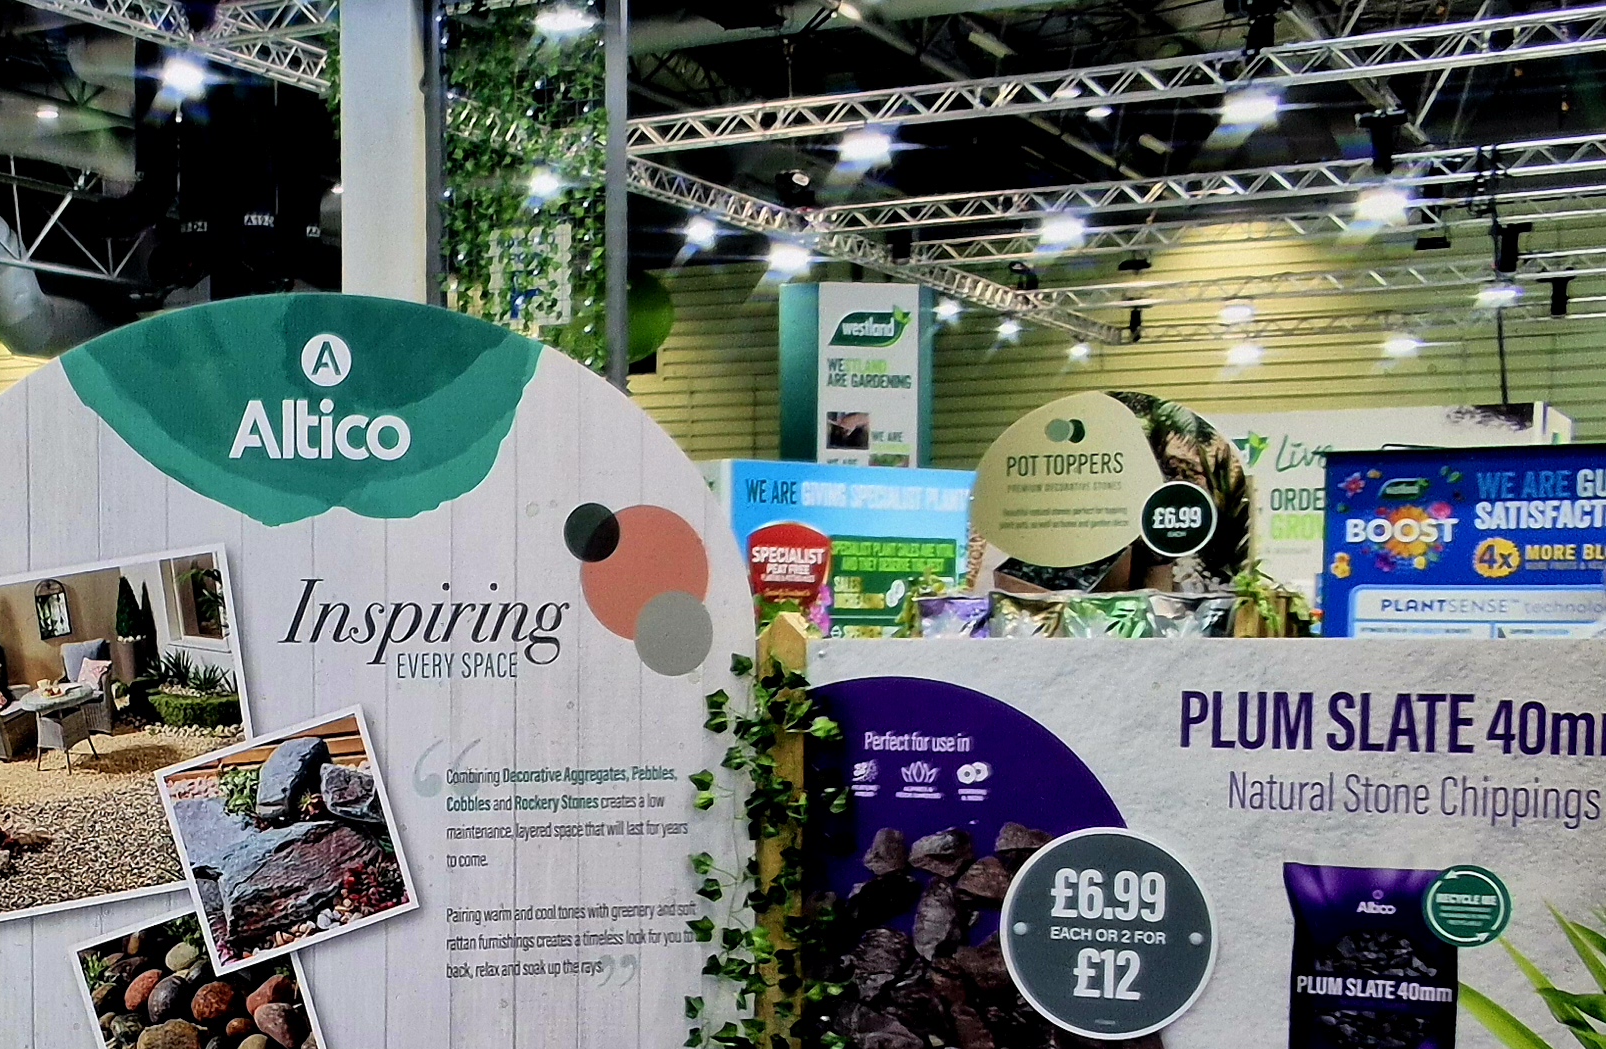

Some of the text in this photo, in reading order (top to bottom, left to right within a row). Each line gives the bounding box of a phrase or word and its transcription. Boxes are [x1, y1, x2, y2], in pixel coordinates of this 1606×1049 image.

[842, 316, 894, 337] westland
[827, 373, 912, 389] ARE GARDENING
[228, 398, 411, 460] Altico
[1006, 452, 1124, 477] POT TOPPERS
[746, 478, 766, 503] WE
[772, 480, 797, 504] ARE
[852, 483, 922, 510] SPECIALIST
[1476, 471, 1515, 499] WE
[1522, 470, 1572, 499] ARE
[1152, 506, 1202, 529] £6.99
[1345, 518, 1459, 543] BOOST
[751, 546, 825, 565] SPECIALIST
[1478, 544, 1513, 570] 4x
[1525, 544, 1576, 561] MORE
[766, 563, 811, 575] PEAT FREE
[278, 578, 570, 665] Inspiring
[396, 652, 518, 679] EVERY SPACE
[1179, 690, 1314, 751] PLUM
[1326, 691, 1476, 754] SLATE
[864, 730, 971, 752] Perfect for use in
[446, 766, 678, 787] Combining Decorative Aggregates, Pebbles,
[446, 794, 665, 813] Cobbles and Rockery Stones creates a low
[1228, 771, 1602, 830] Natural Stone Chippings
[1050, 867, 1167, 923] £6.99
[446, 901, 696, 925] Pairing warm and cool tones with greenery and soft
[1356, 901, 1397, 915] Altico
[1050, 926, 1167, 945] EACH OR 2 FOR
[1073, 947, 1142, 1000] £12
[1297, 975, 1454, 1003] PLUM SLATE 40mm
